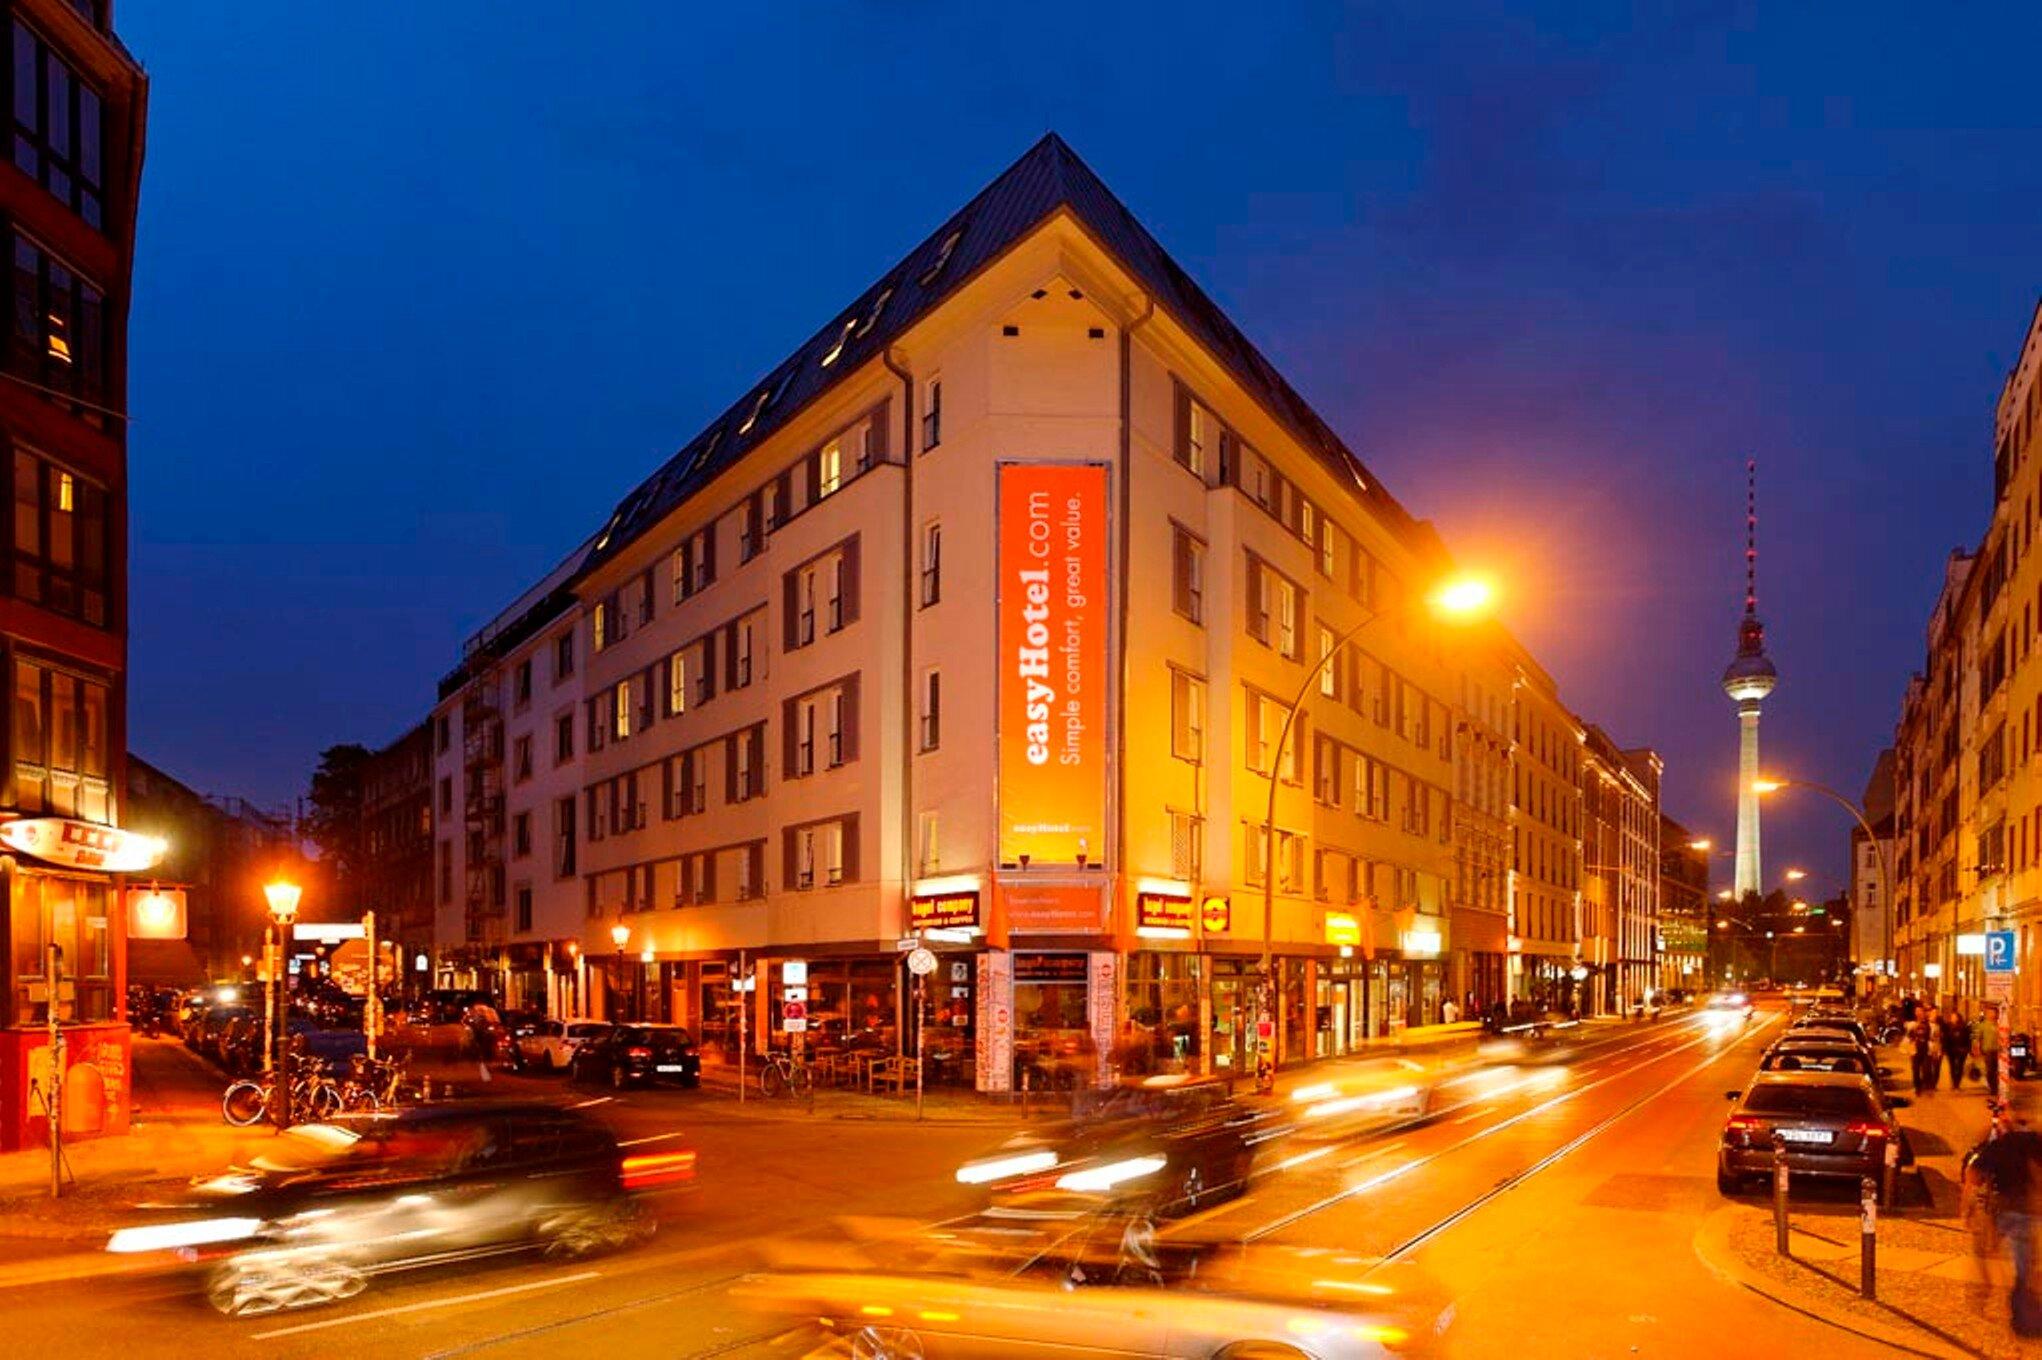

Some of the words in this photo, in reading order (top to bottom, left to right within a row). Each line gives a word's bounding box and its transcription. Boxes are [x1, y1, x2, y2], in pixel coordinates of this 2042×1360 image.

[1060, 492, 1081, 551] value.
[1064, 556, 1087, 607] great
[1019, 491, 1055, 765] easyHotel.com
[1060, 615, 1084, 693] comfort,
[1060, 700, 1086, 765] Simple
[1989, 937, 2006, 966] P
